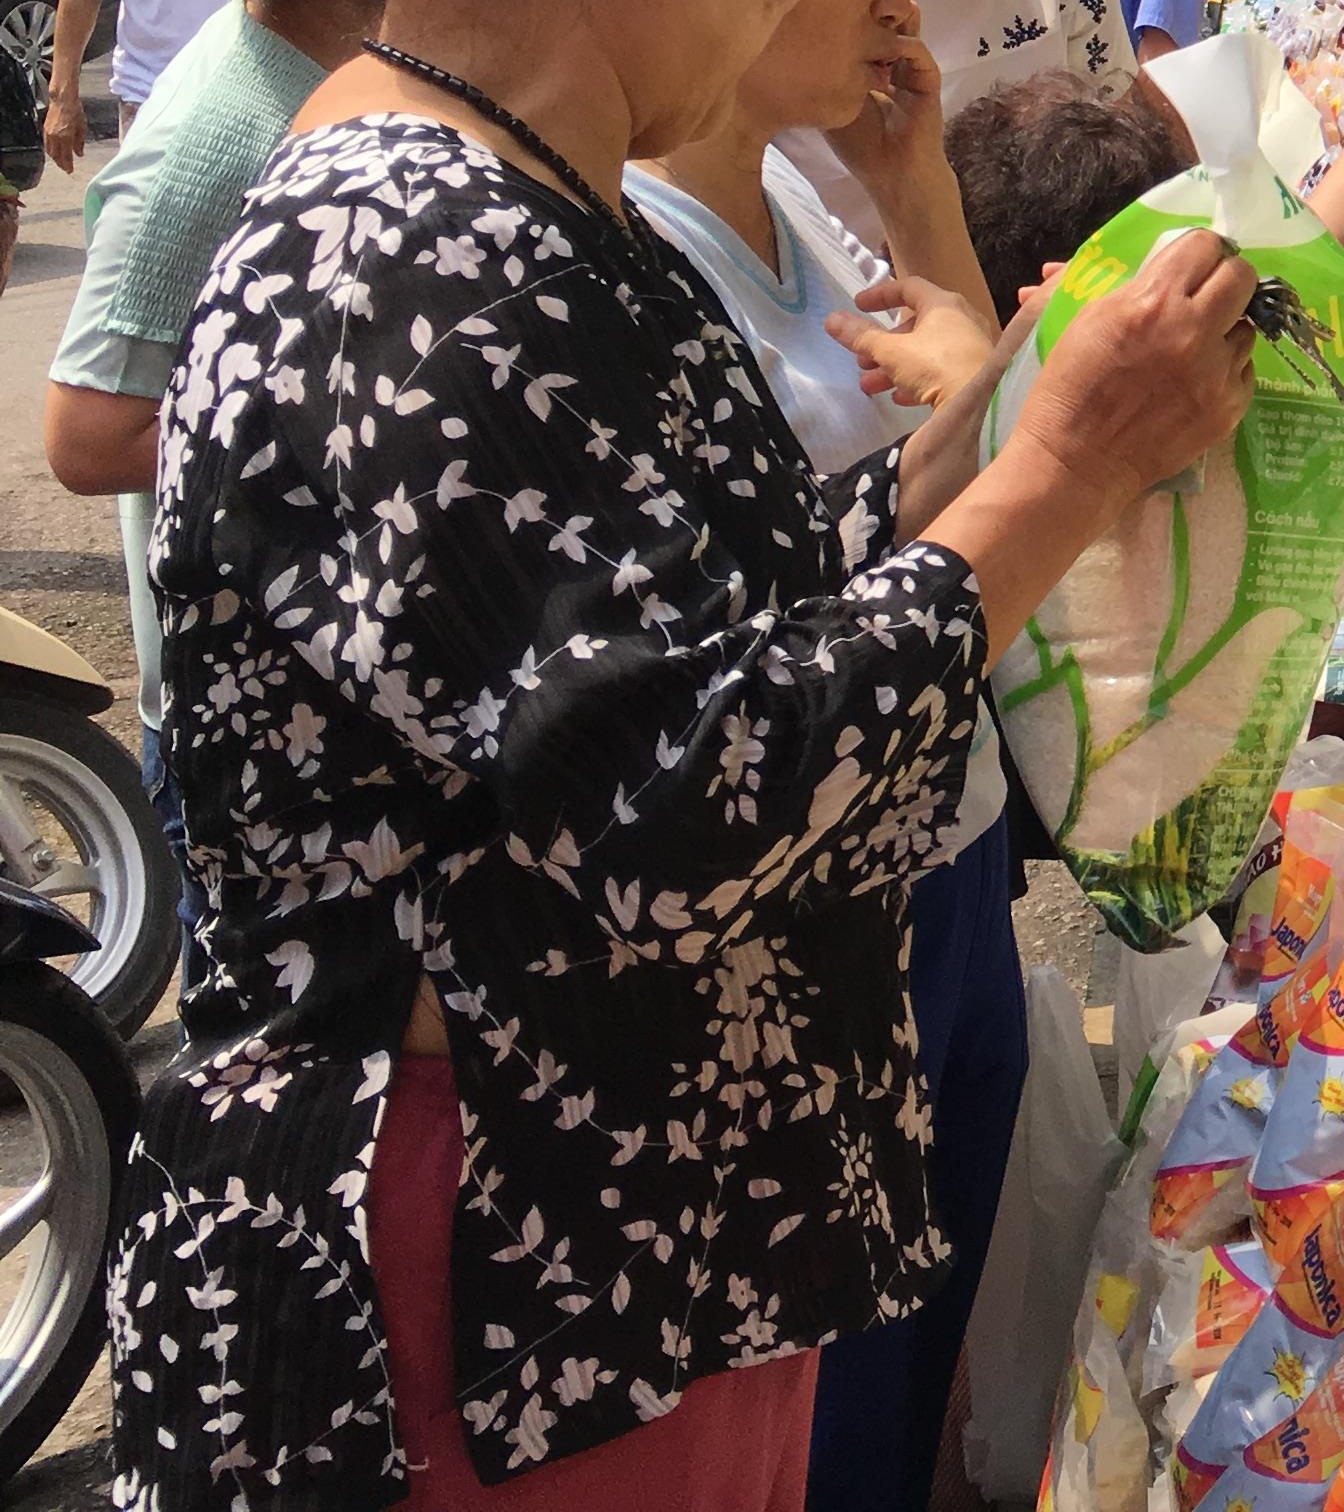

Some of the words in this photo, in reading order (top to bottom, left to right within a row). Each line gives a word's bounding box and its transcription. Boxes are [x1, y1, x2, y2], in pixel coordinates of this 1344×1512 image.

[1254, 510, 1294, 526] Cách
[1271, 917, 1306, 960] Japon
[1279, 1416, 1310, 1475] nica
